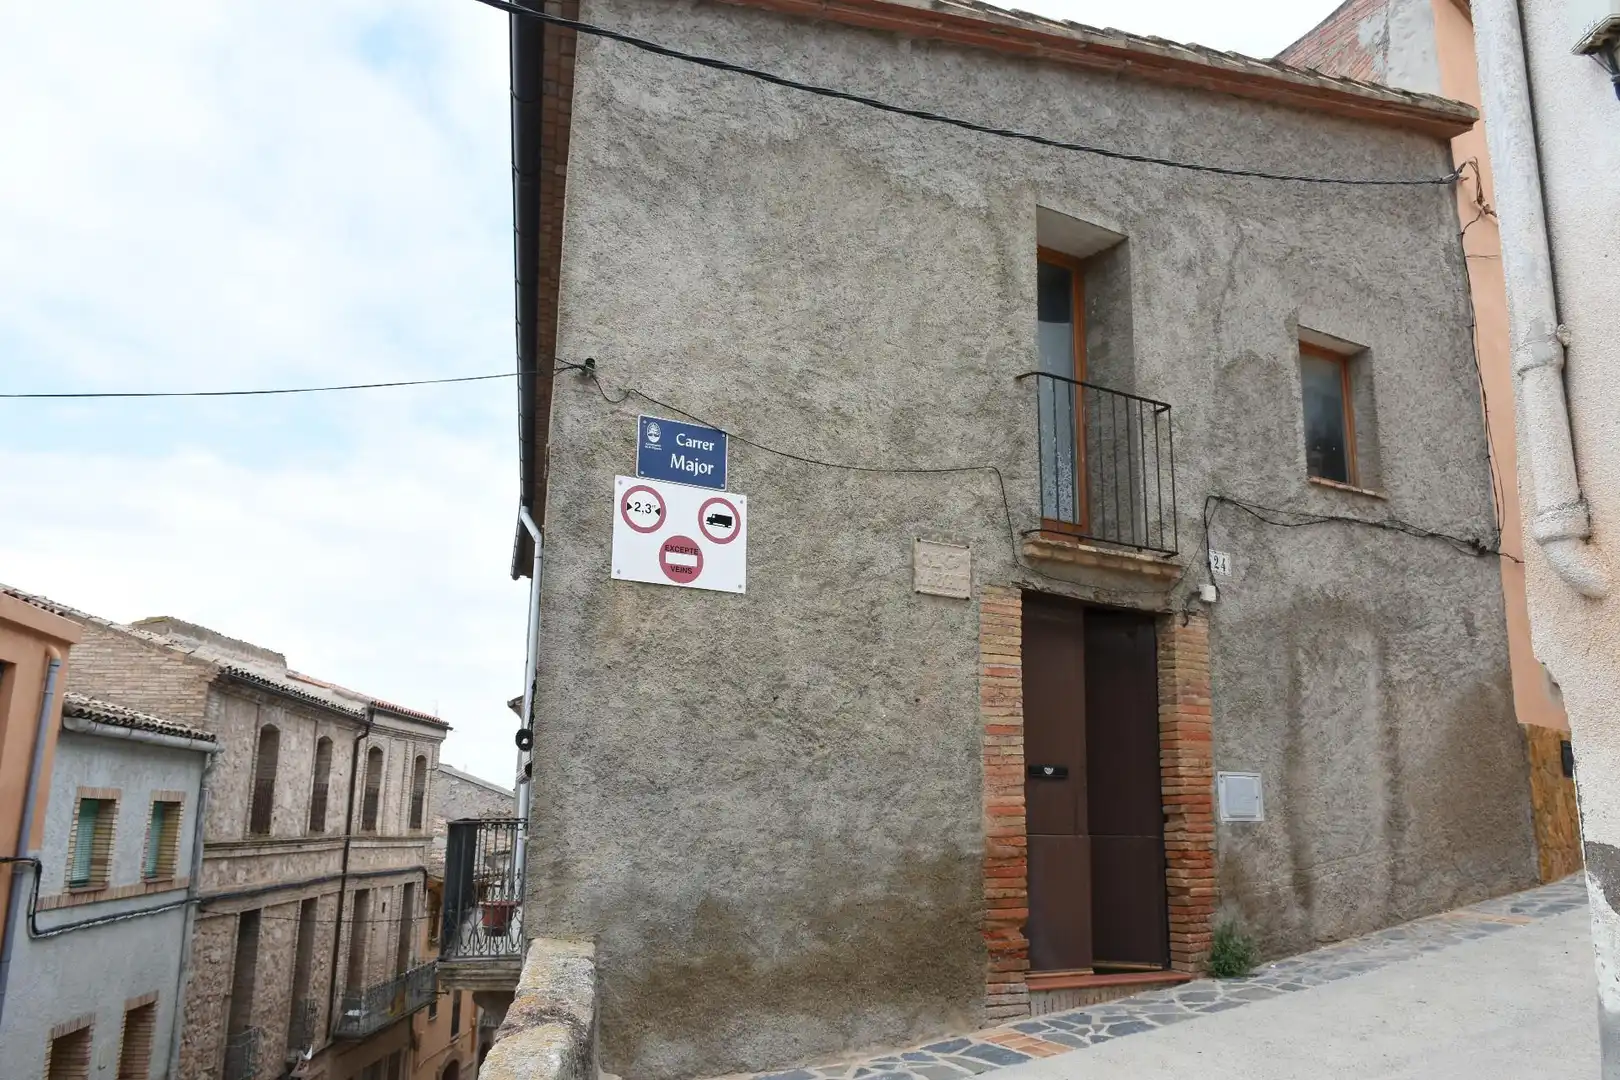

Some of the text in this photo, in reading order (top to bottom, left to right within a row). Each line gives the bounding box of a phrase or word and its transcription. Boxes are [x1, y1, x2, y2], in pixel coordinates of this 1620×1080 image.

[676, 433, 714, 451] Carrer
[670, 453, 714, 476] Major
[664, 544, 699, 556] EXCEPTE
[1213, 555, 1226, 571] 24
